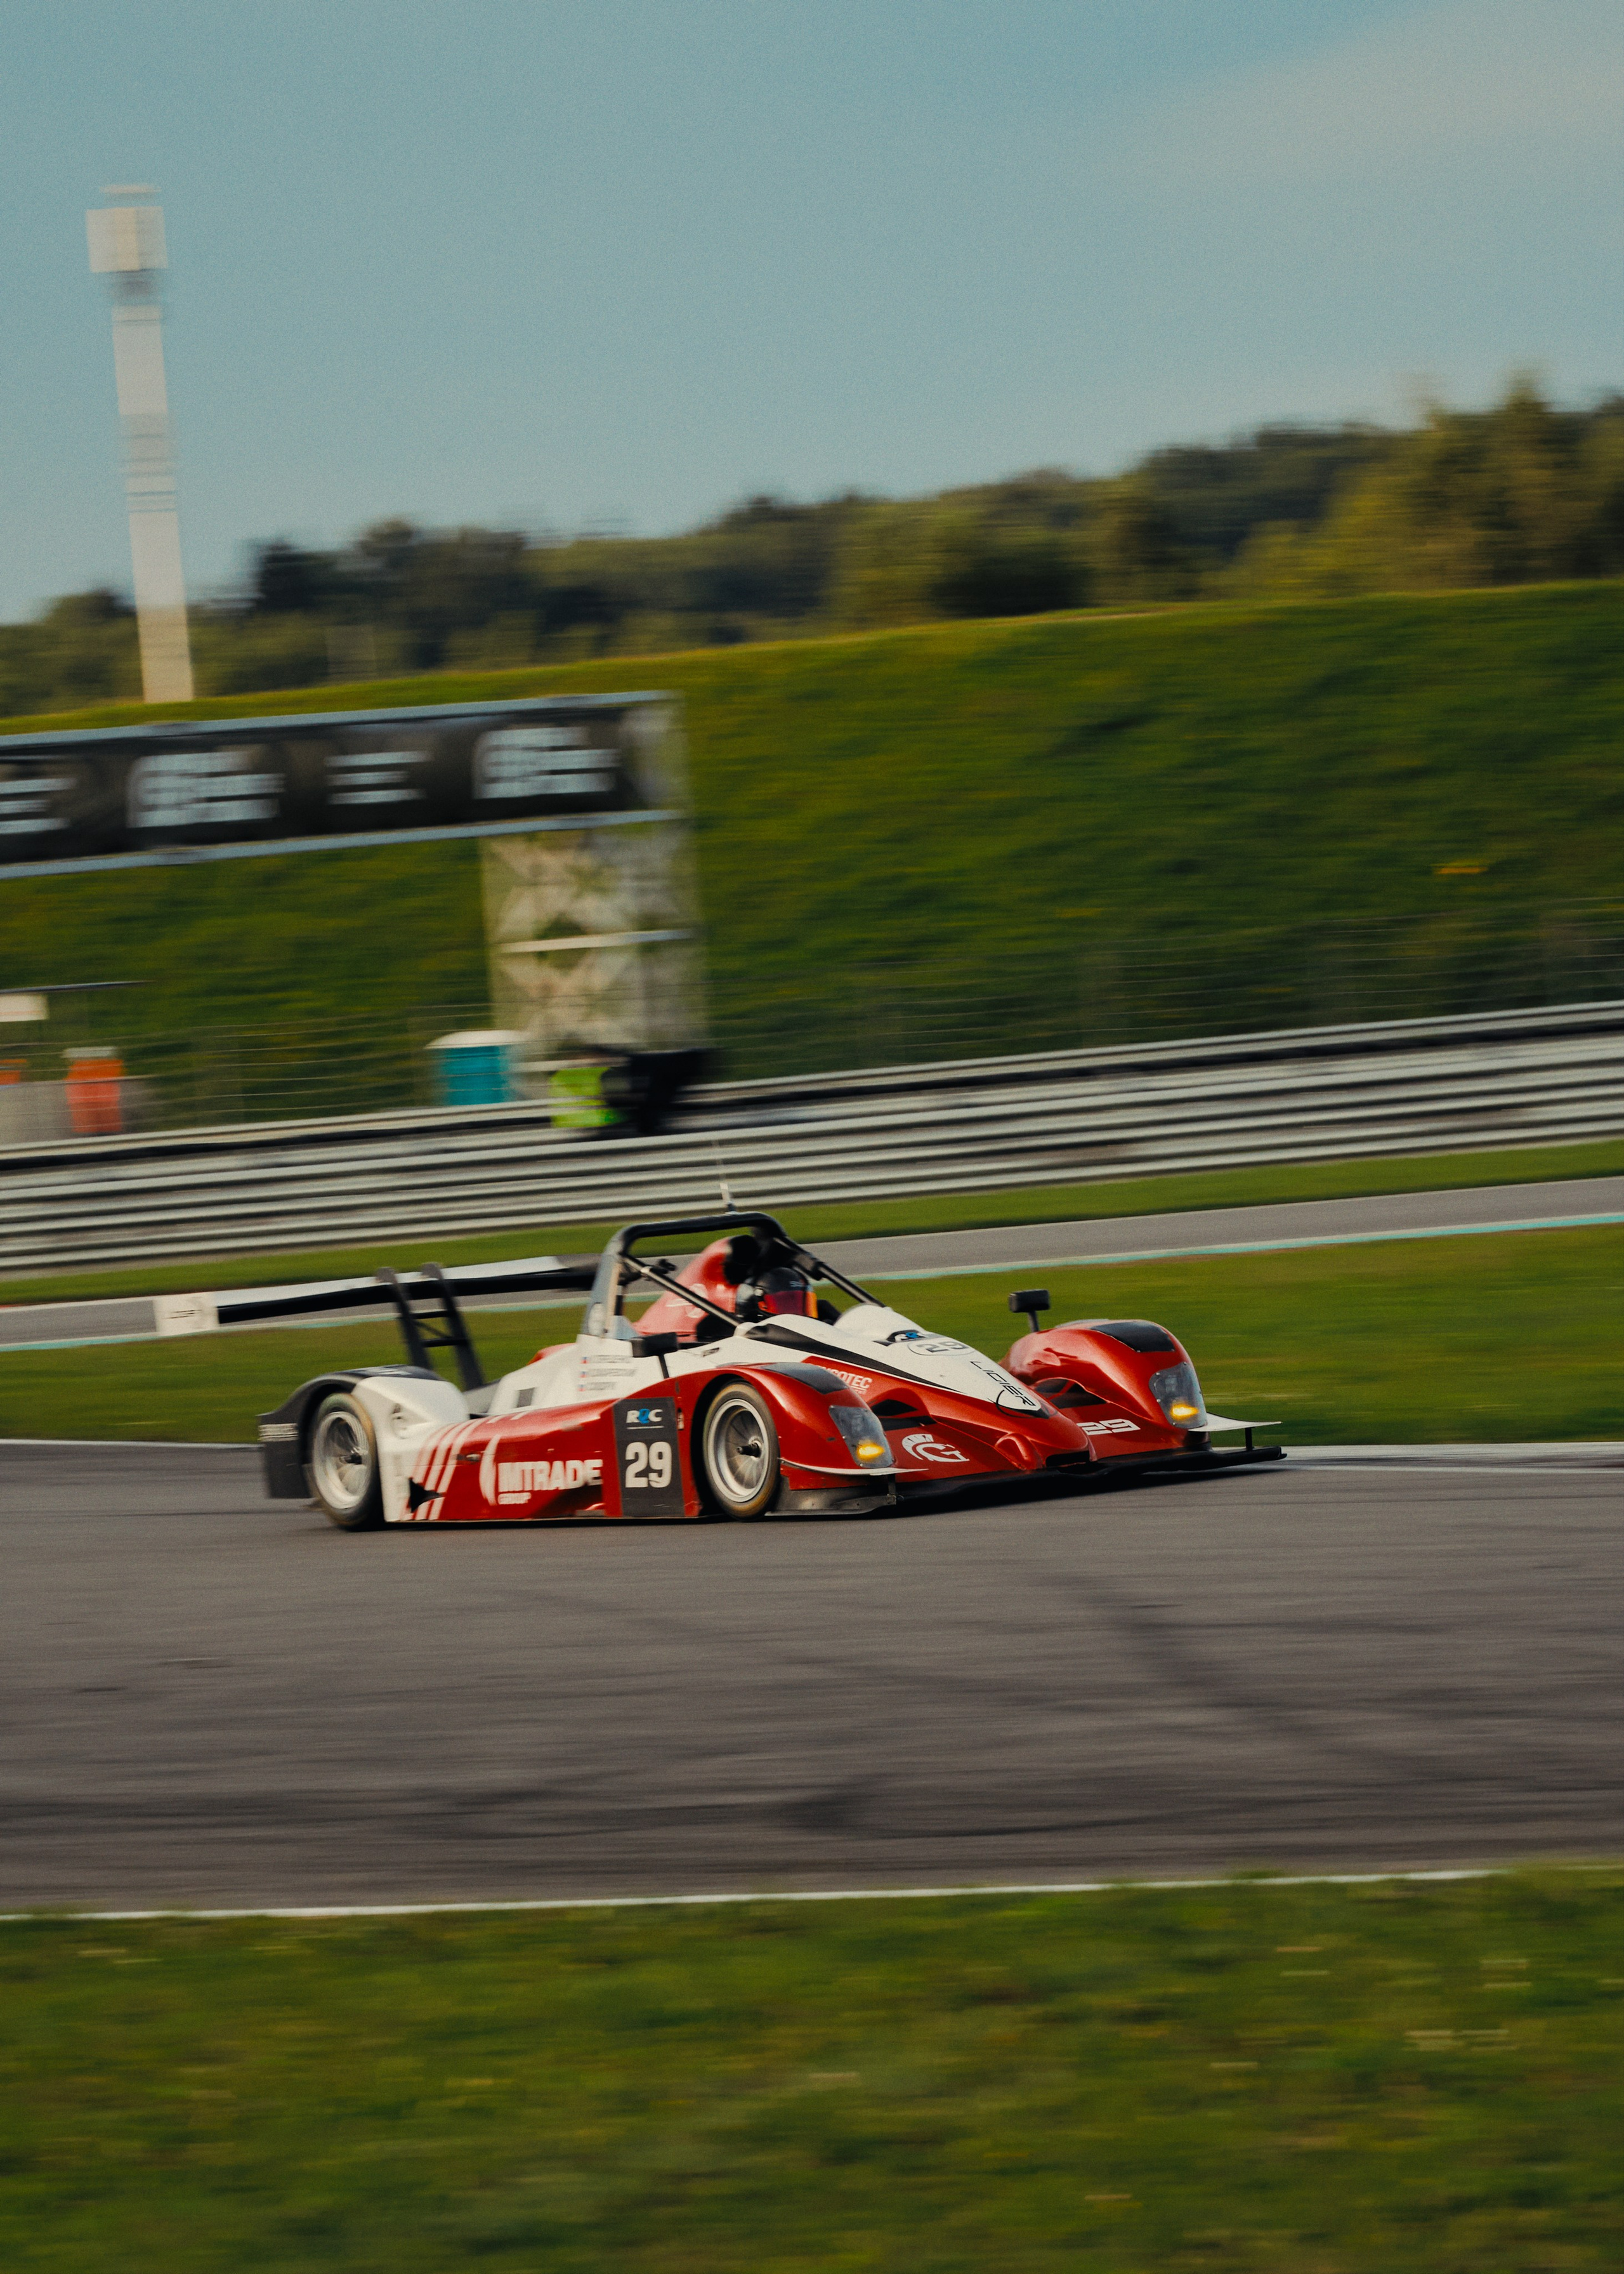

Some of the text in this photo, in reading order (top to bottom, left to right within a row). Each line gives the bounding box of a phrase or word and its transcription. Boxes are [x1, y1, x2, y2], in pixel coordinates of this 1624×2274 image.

[916, 1341, 969, 1353] 29
[970, 1361, 1036, 1406] LIGIER
[1078, 1419, 1141, 1436] 29
[625, 1442, 672, 1488] 29
